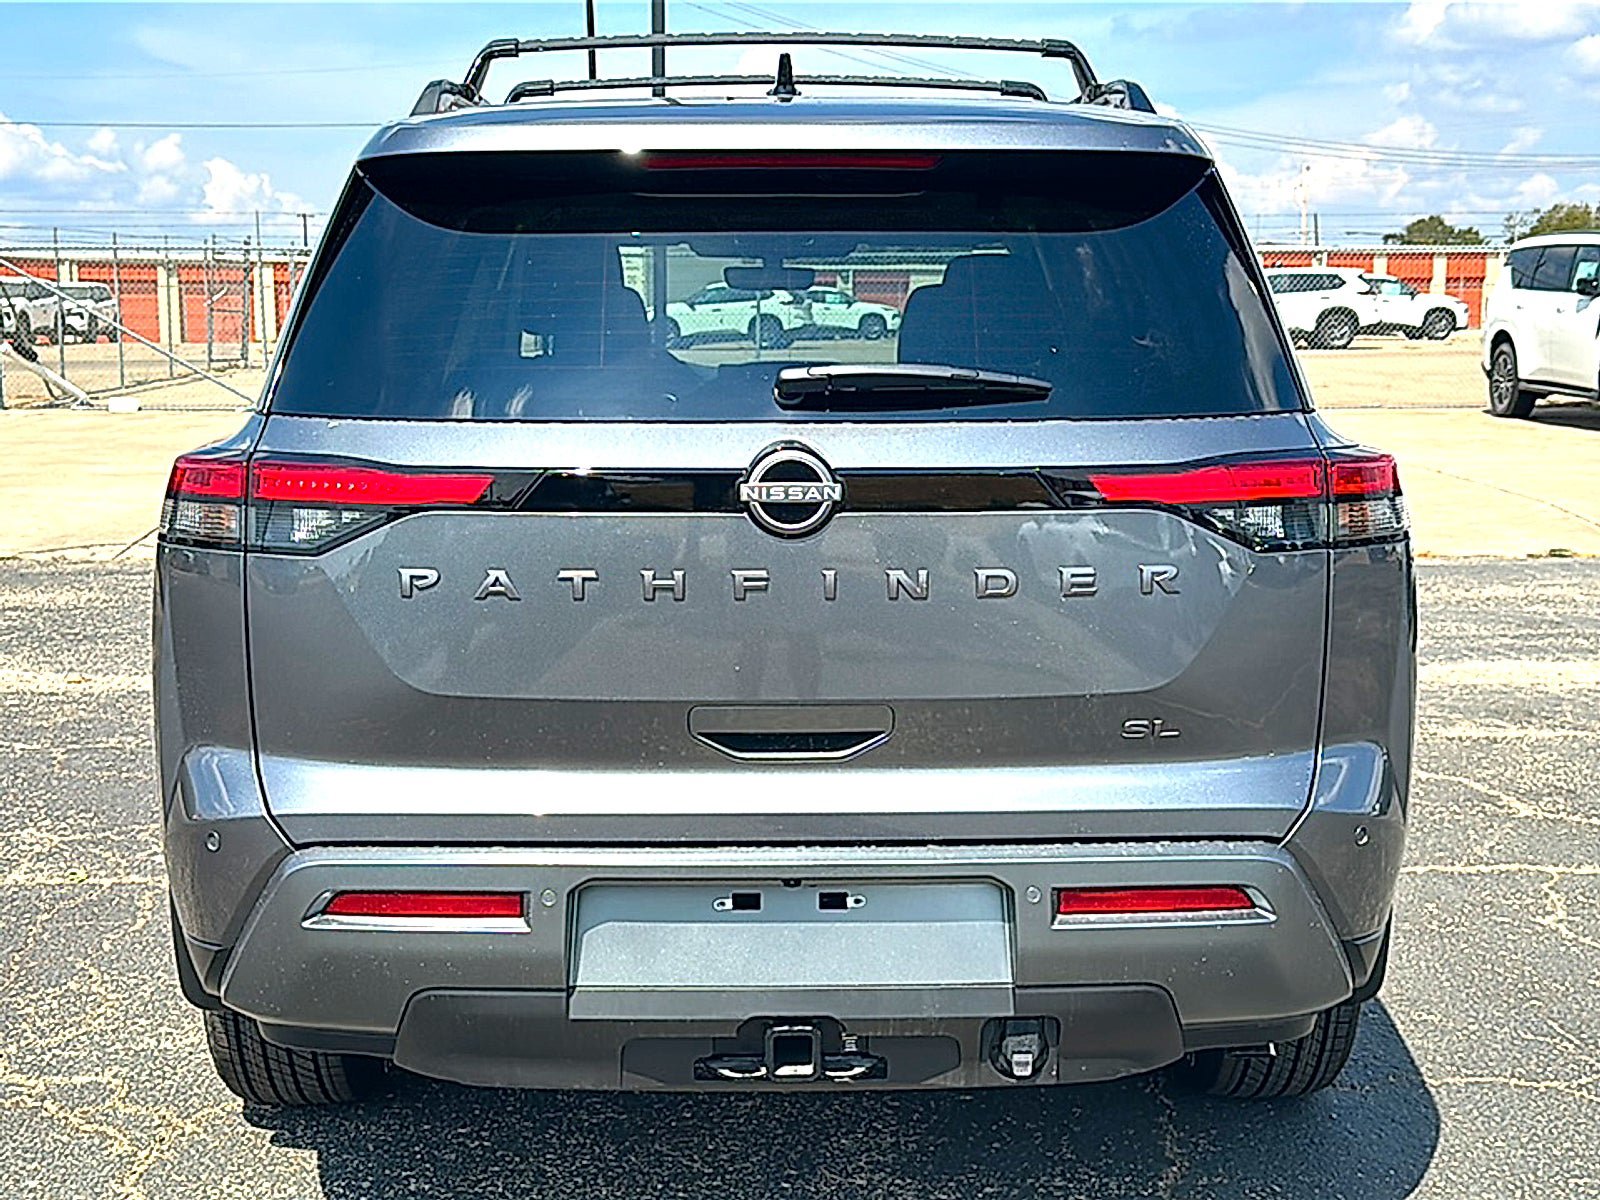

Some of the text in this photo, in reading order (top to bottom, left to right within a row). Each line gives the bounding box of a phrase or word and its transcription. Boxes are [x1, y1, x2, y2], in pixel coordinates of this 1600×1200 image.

[742, 484, 840, 501] NISSAN
[398, 564, 1181, 602] PATHFINDER
[1121, 718, 1181, 739] SL
